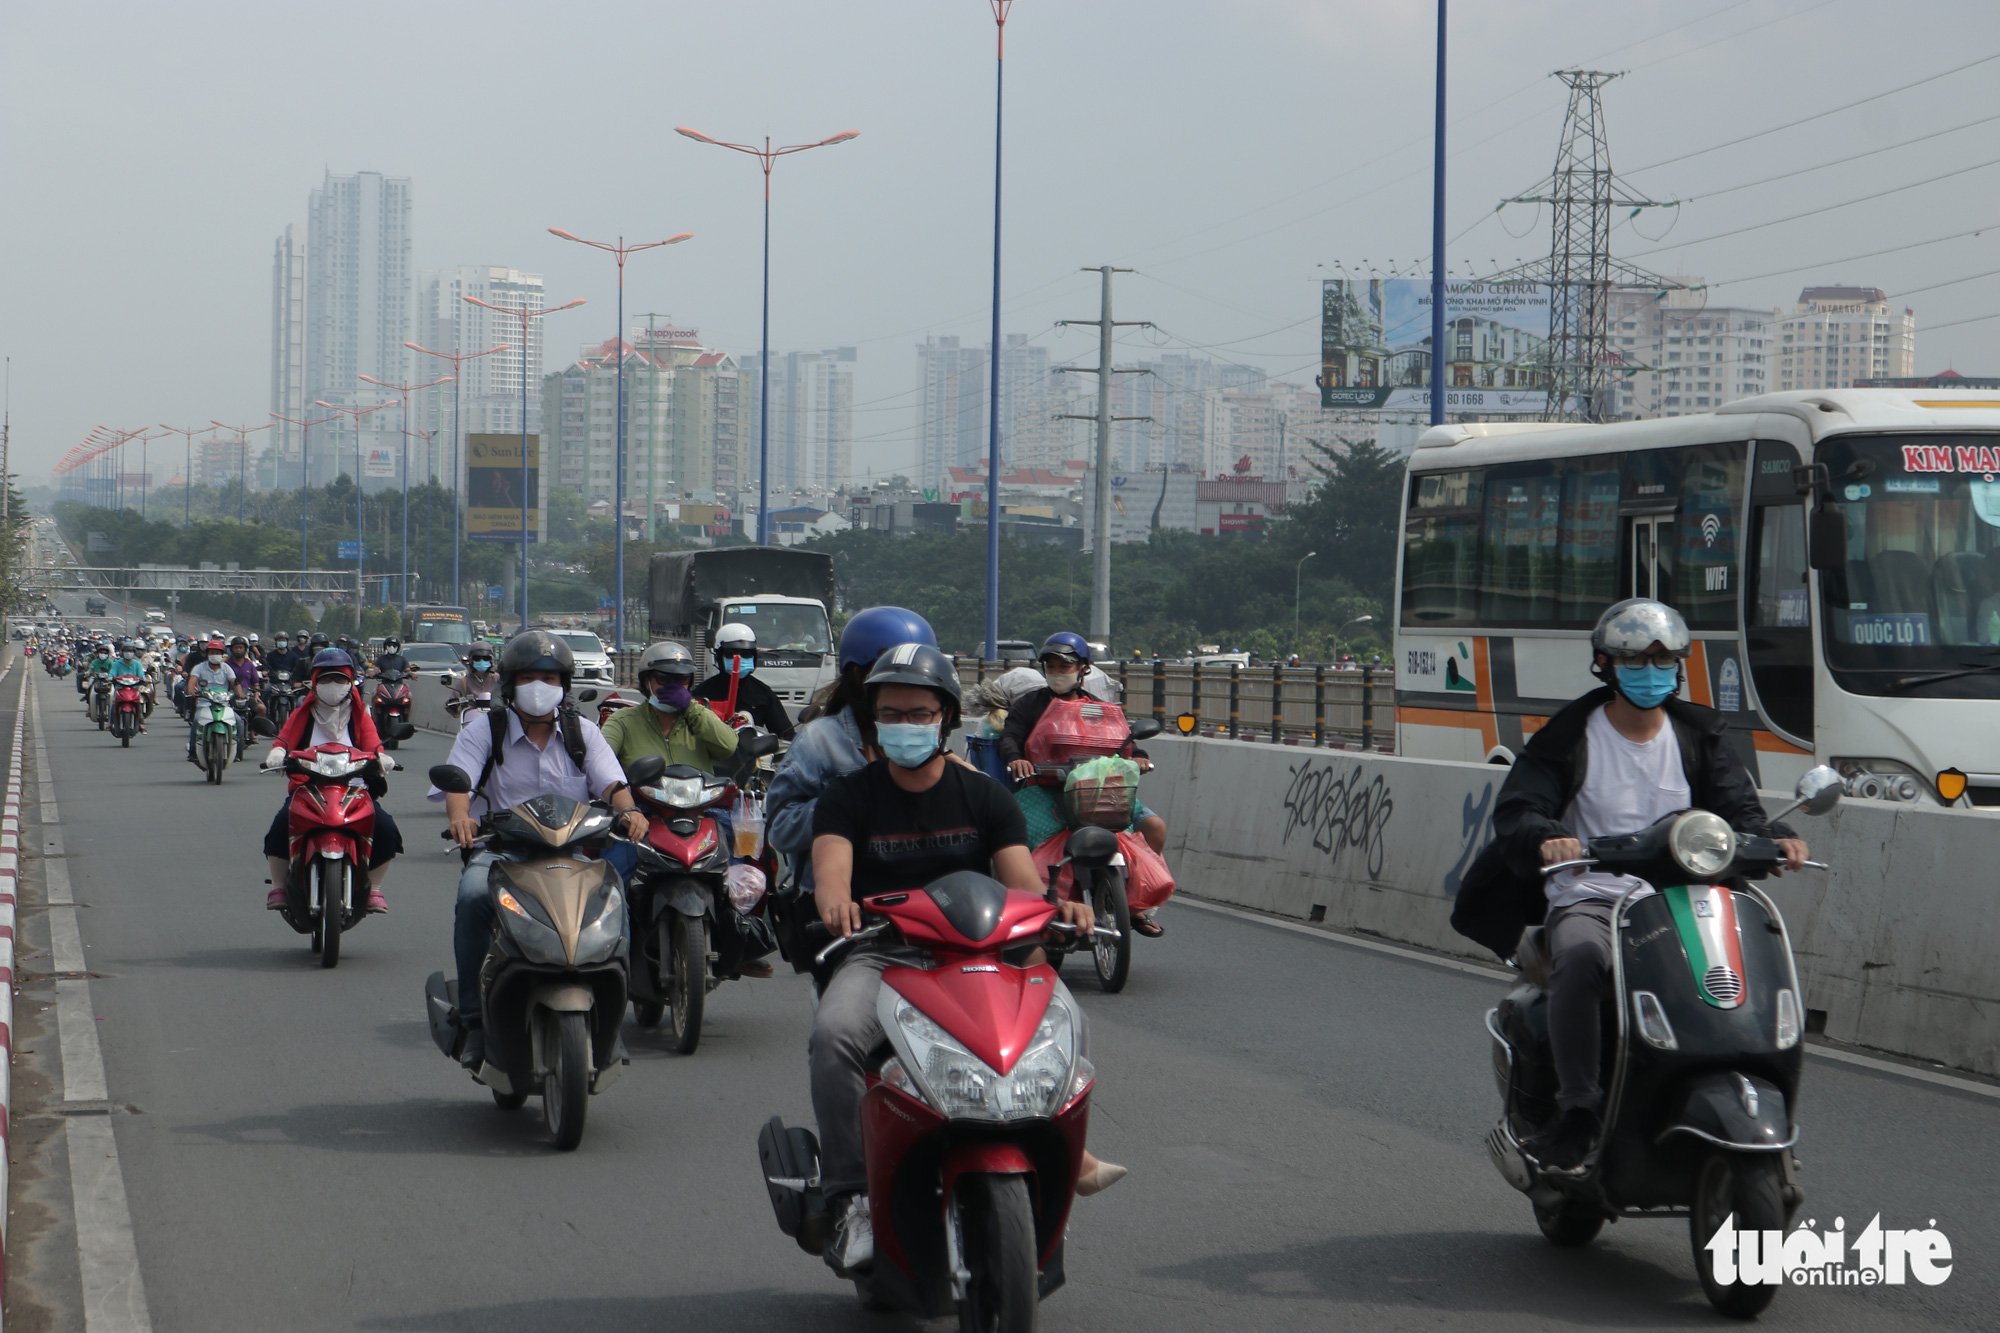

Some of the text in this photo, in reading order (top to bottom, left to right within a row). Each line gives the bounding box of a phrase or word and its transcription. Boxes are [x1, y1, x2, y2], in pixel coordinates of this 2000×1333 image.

[1431, 283, 1540, 295] AMOND CENTRAL
[1529, 298, 1548, 306] VINH
[1447, 394, 1459, 405] 80
[1462, 394, 1484, 405] 1668
[491, 447, 512, 457] Sun
[1902, 445, 1955, 472] KIM
[1761, 459, 1791, 474] SAMCO
[1705, 566, 1728, 591] WIFI
[1854, 618, 1925, 646] QUỐC LỘ 1
[868, 830, 979, 854] BREAK RULES
[961, 964, 1000, 975] HONDA
